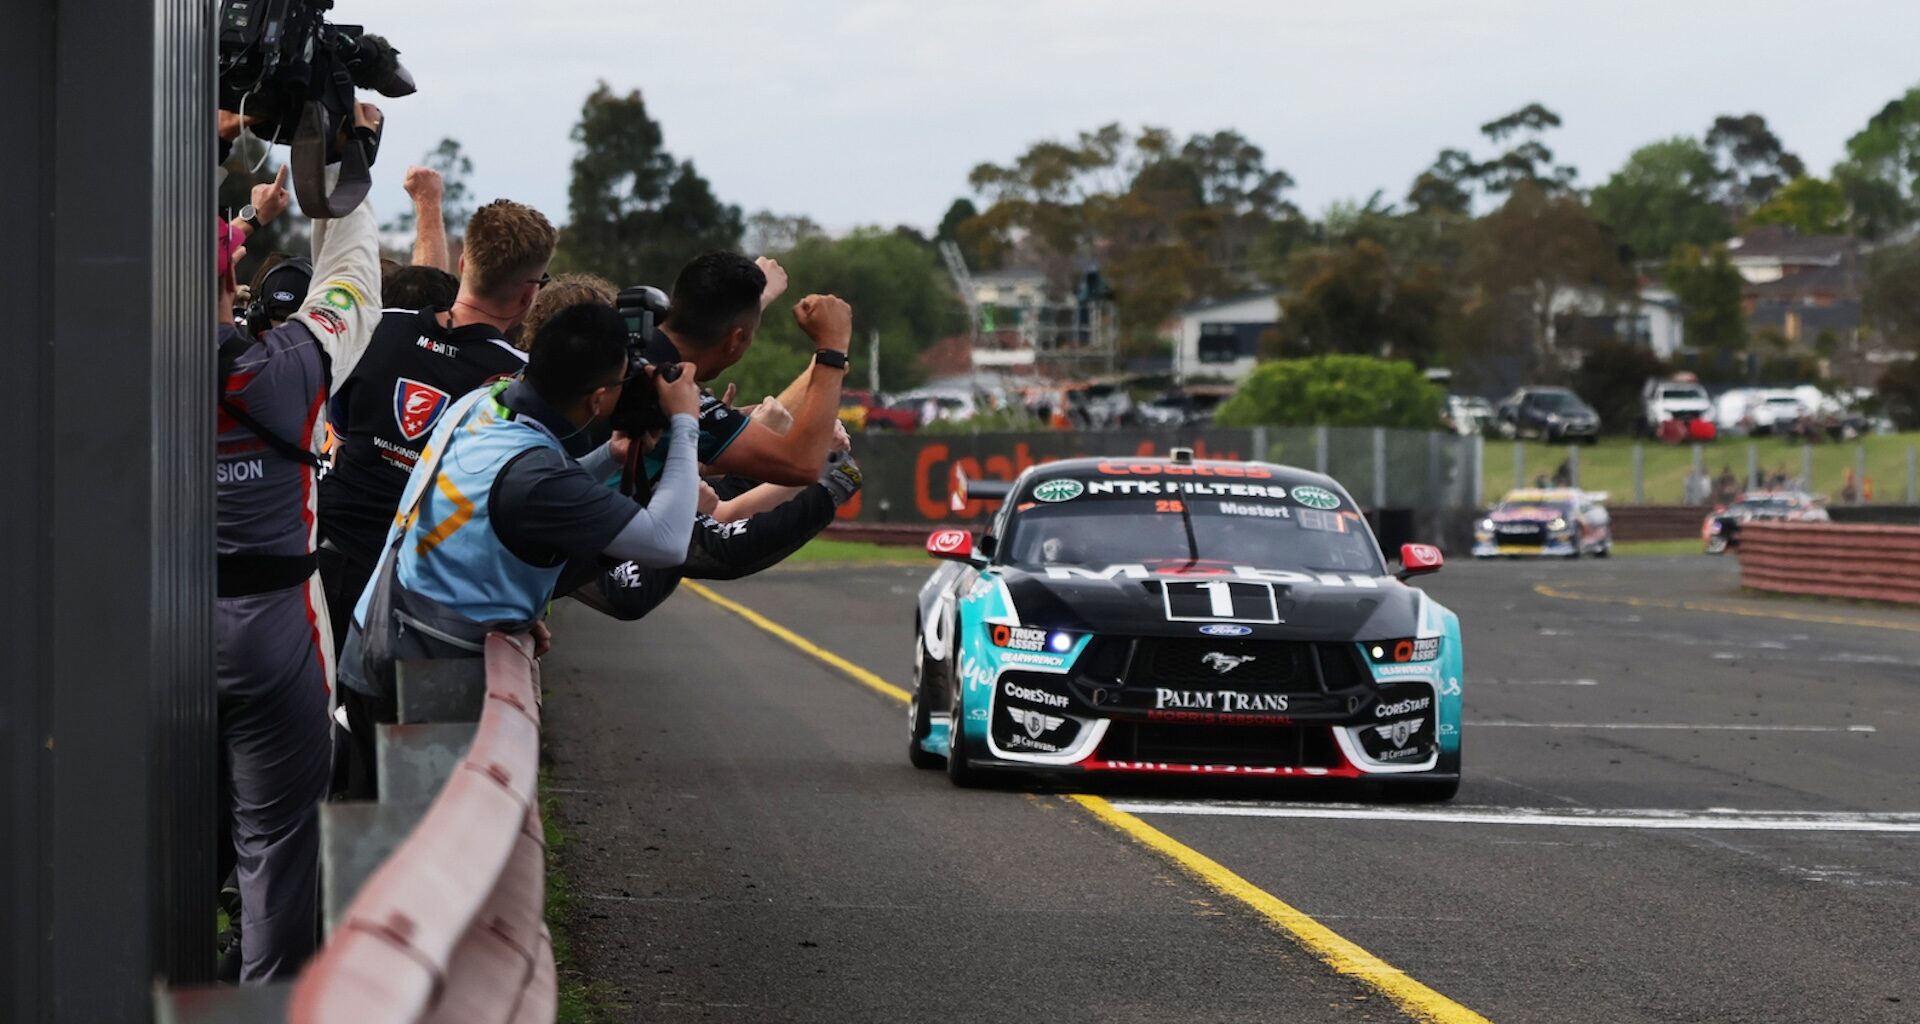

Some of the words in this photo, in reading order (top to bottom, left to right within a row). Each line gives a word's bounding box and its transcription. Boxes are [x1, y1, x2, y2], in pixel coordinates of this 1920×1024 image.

[416, 336, 446, 355] Mobil
[1097, 462, 1272, 479] Coates
[1088, 481, 1161, 494] NTK
[1166, 481, 1286, 499] FILTERS
[1155, 500, 1184, 512] 25
[1219, 502, 1290, 519] Mostert
[1196, 582, 1234, 617] 1
[1011, 628, 1047, 642] TRUCK
[1006, 638, 1045, 652] ASSIST
[1155, 687, 1213, 709] PALM
[1218, 690, 1289, 712] TRANS
